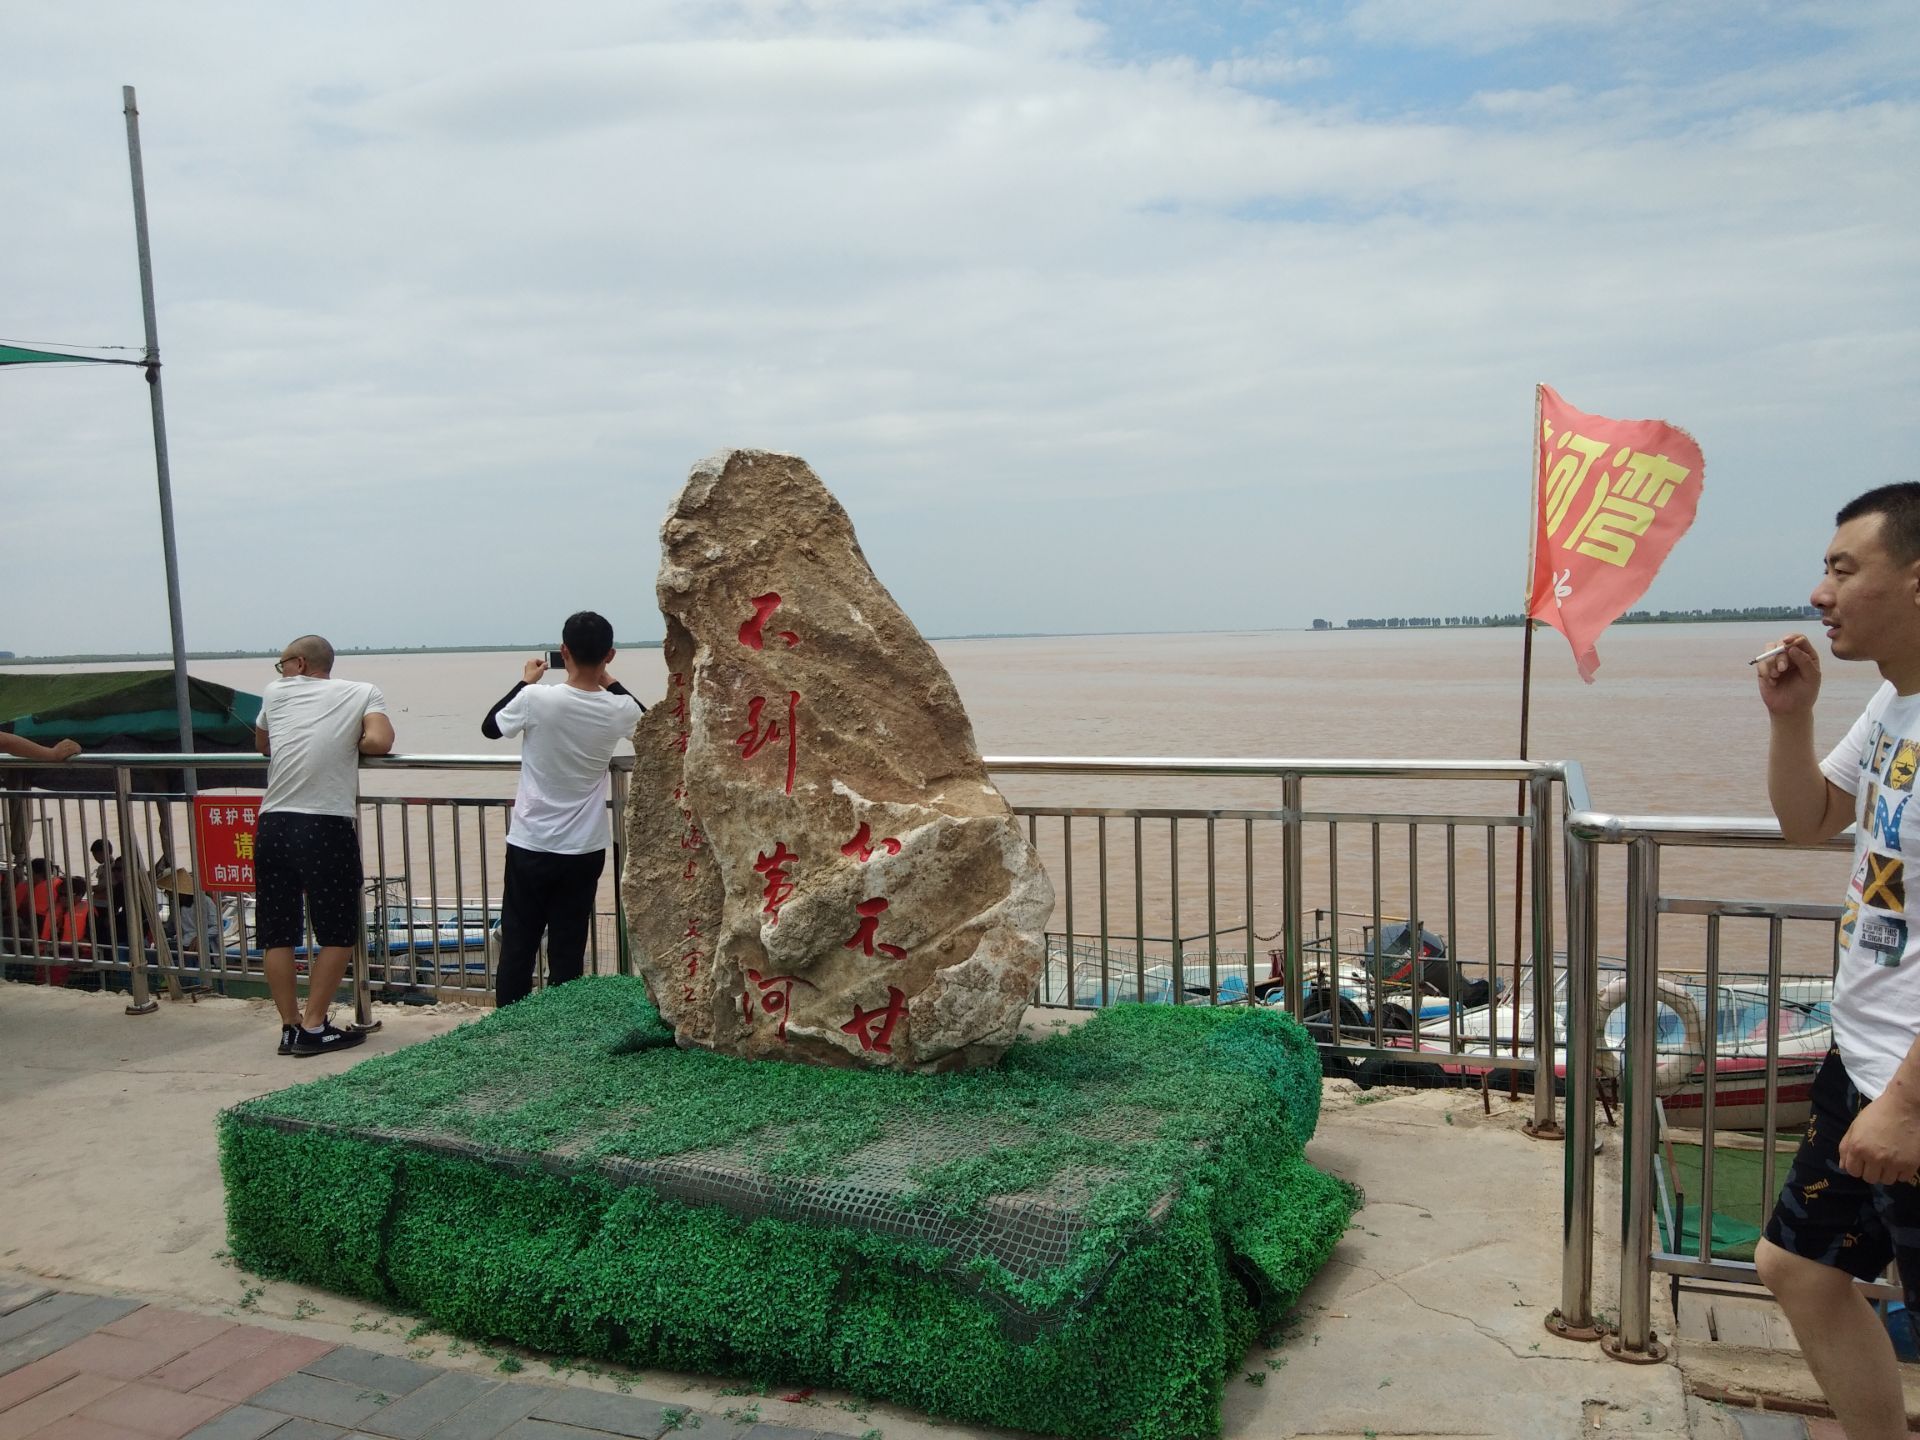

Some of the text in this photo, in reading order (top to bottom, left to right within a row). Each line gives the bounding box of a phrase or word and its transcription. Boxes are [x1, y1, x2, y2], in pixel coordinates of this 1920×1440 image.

[1543, 418, 1691, 568] 河湾
[209, 807, 256, 826] 保护母
[233, 832, 254, 860] 请
[214, 864, 254, 883] 向河内
[1884, 927, 1898, 937] THIS
